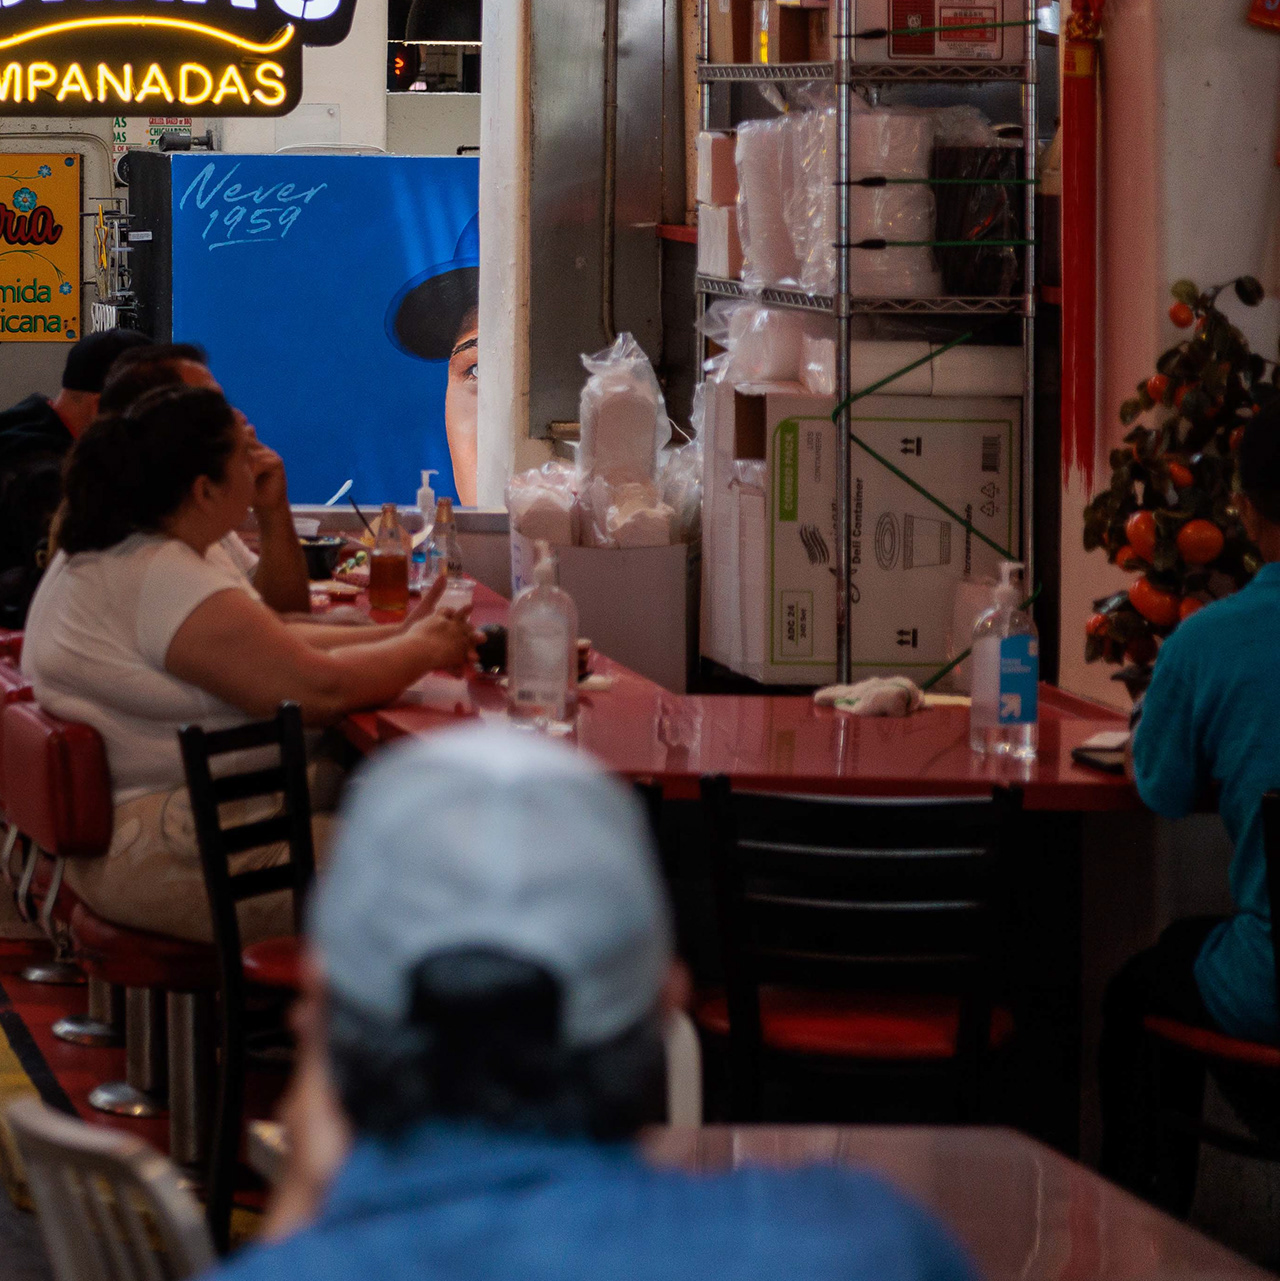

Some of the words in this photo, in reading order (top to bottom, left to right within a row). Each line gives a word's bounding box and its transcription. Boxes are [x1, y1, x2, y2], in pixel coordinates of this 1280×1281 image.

[179, 162, 328, 210] Never
[202, 205, 302, 240] 1959
[783, 432, 794, 463] PACK
[852, 477, 863, 536] Container
[852, 537, 862, 564] Deli
